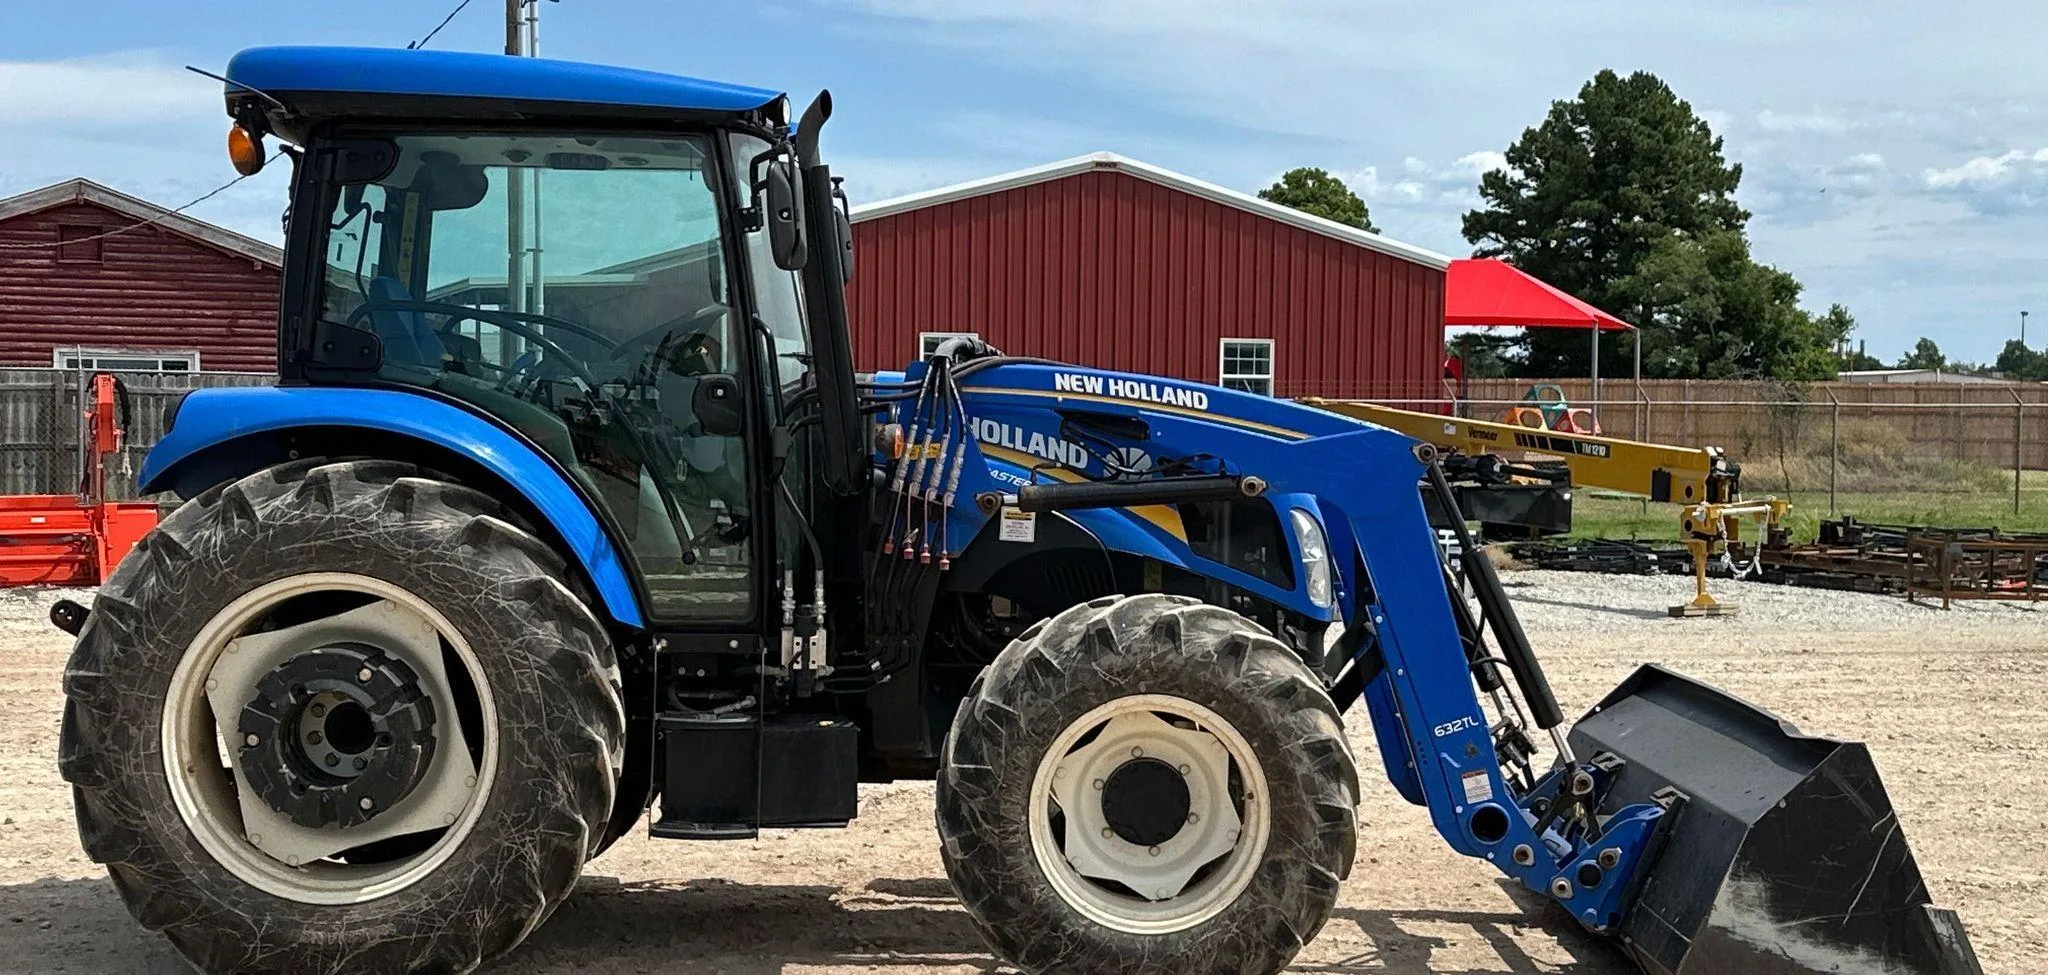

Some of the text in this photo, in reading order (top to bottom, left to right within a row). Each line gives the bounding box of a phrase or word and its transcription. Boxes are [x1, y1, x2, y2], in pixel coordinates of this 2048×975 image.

[1054, 372, 1209, 411] NEW HOLLAND
[970, 416, 1089, 469] HOLLAND
[1467, 425, 1498, 441] Vermeer
[989, 467, 1032, 487] ASTER
[1434, 715, 1479, 737] 632TL
